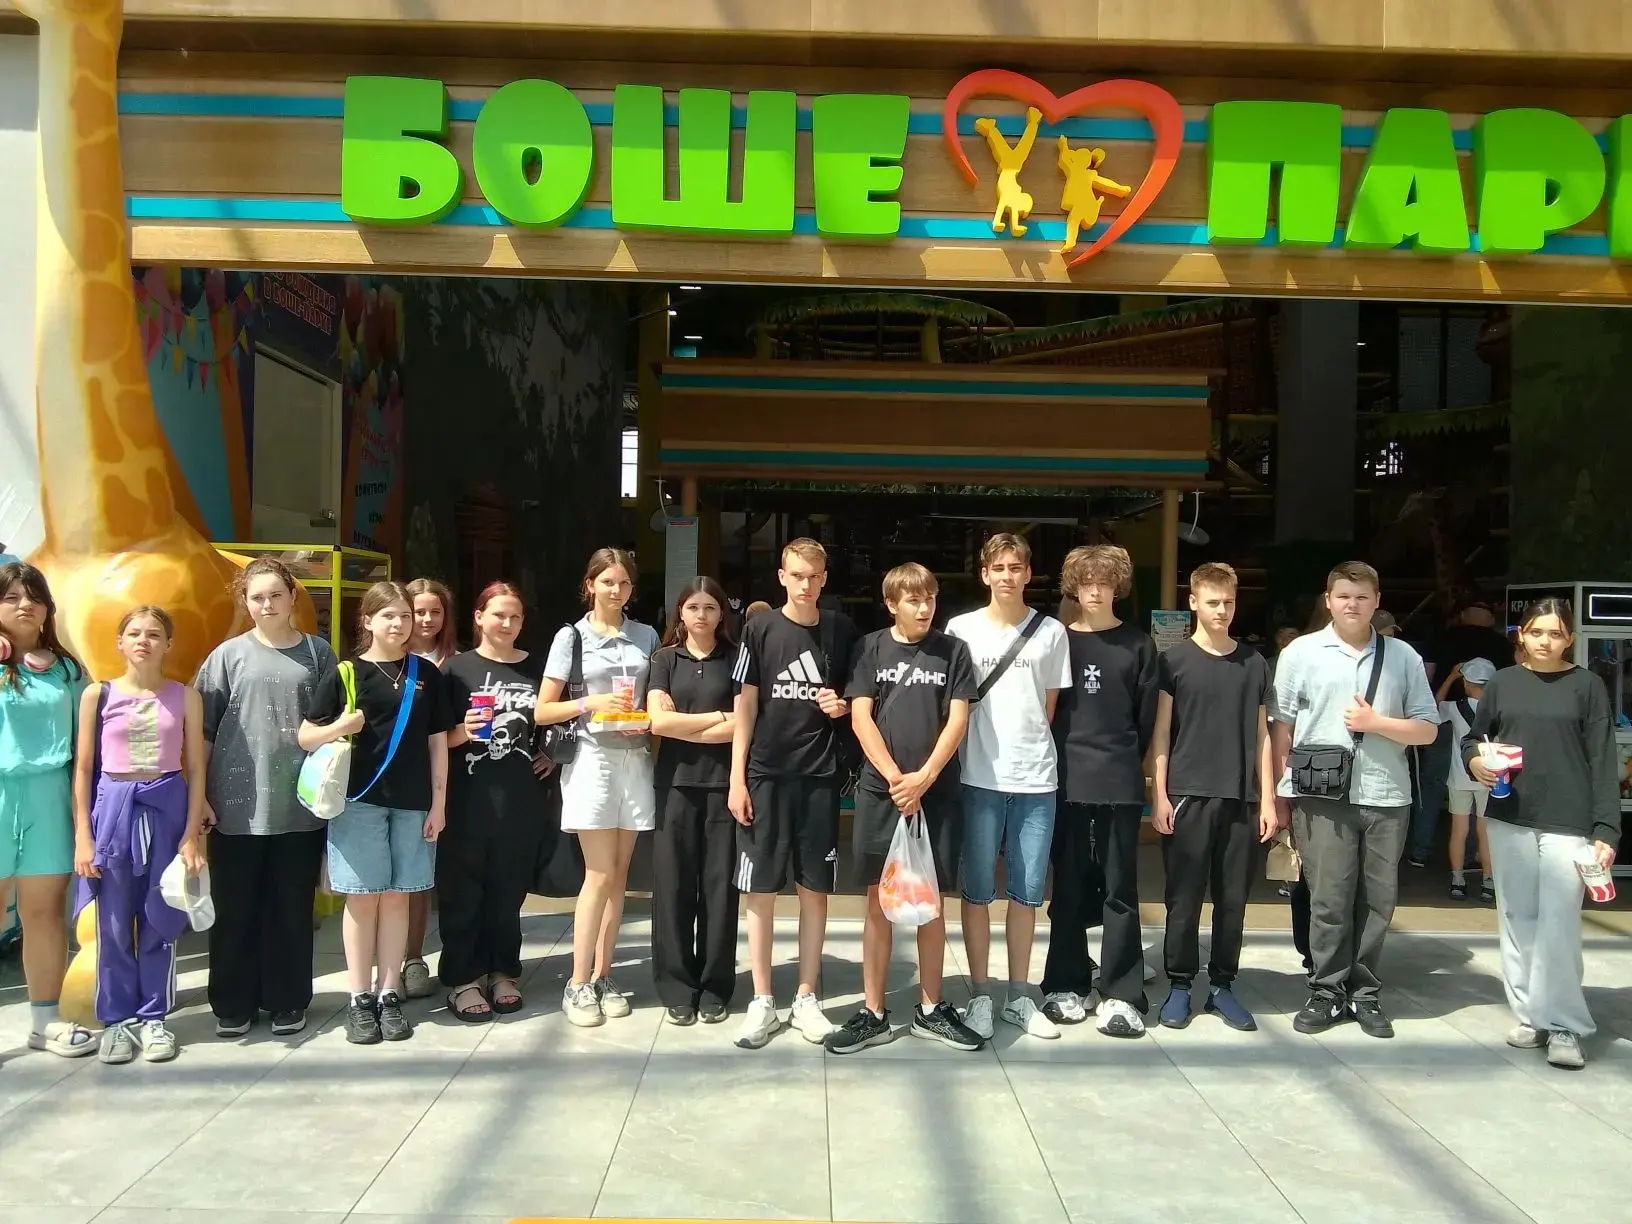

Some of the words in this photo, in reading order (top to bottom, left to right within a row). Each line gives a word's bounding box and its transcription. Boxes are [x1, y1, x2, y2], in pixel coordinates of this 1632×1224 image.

[341, 75, 910, 240] БОШЕ
[1207, 100, 1632, 257] ПАР
[982, 655, 1030, 668] HAEN
[772, 681, 824, 700] adida
